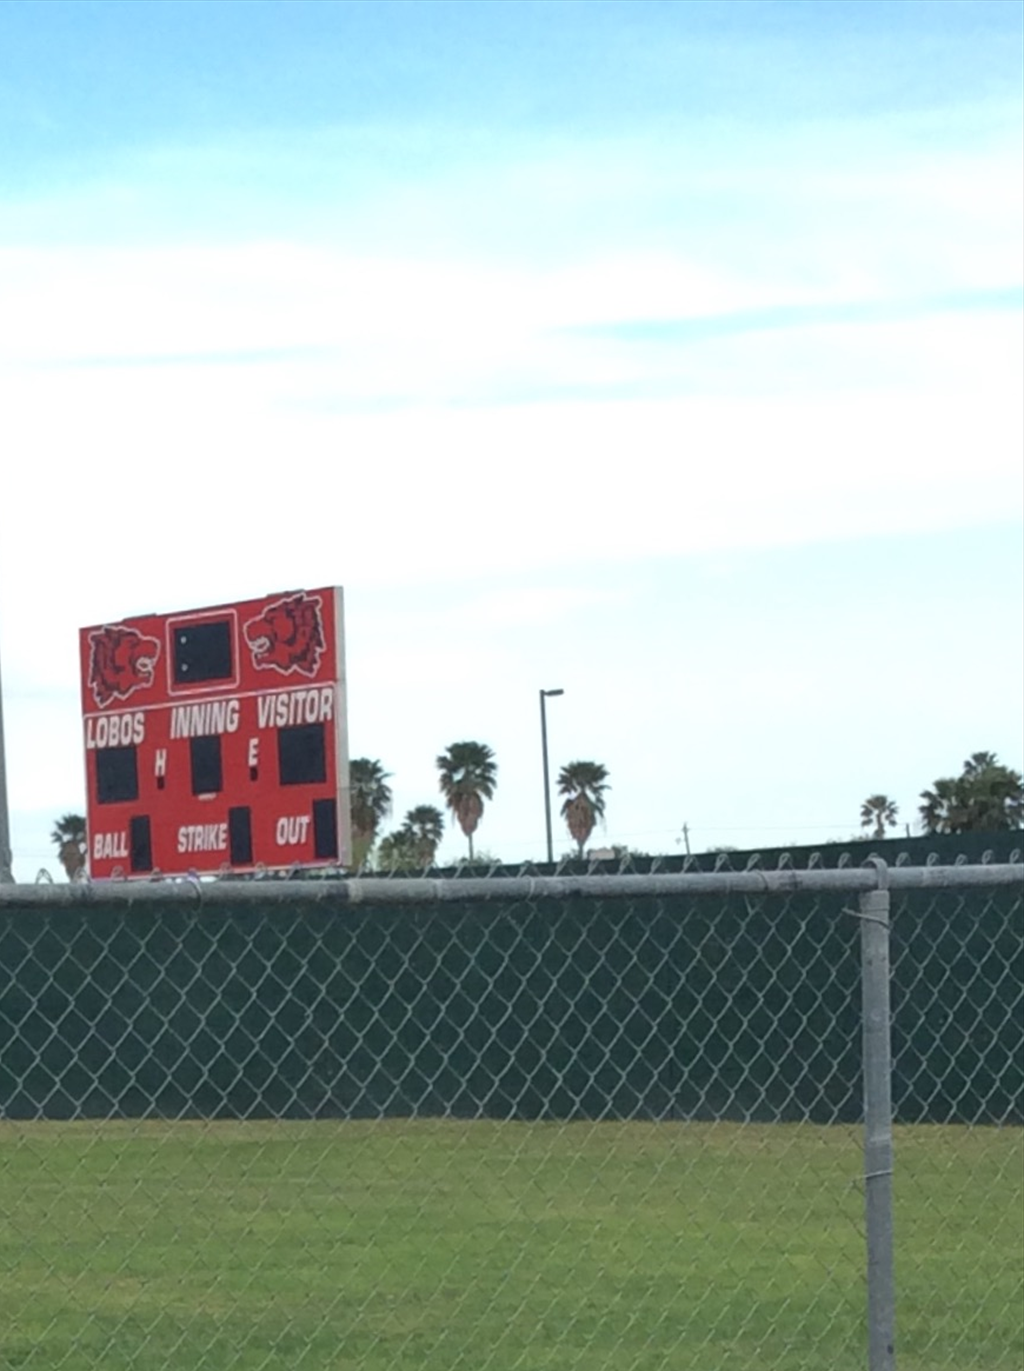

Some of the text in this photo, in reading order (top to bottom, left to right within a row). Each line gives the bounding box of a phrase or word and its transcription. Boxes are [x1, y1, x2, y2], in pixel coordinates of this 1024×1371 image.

[86, 688, 334, 749] LOBOS INNING VISITOR
[154, 738, 259, 777] H E
[93, 816, 310, 859] BALL STRIKE OUT
